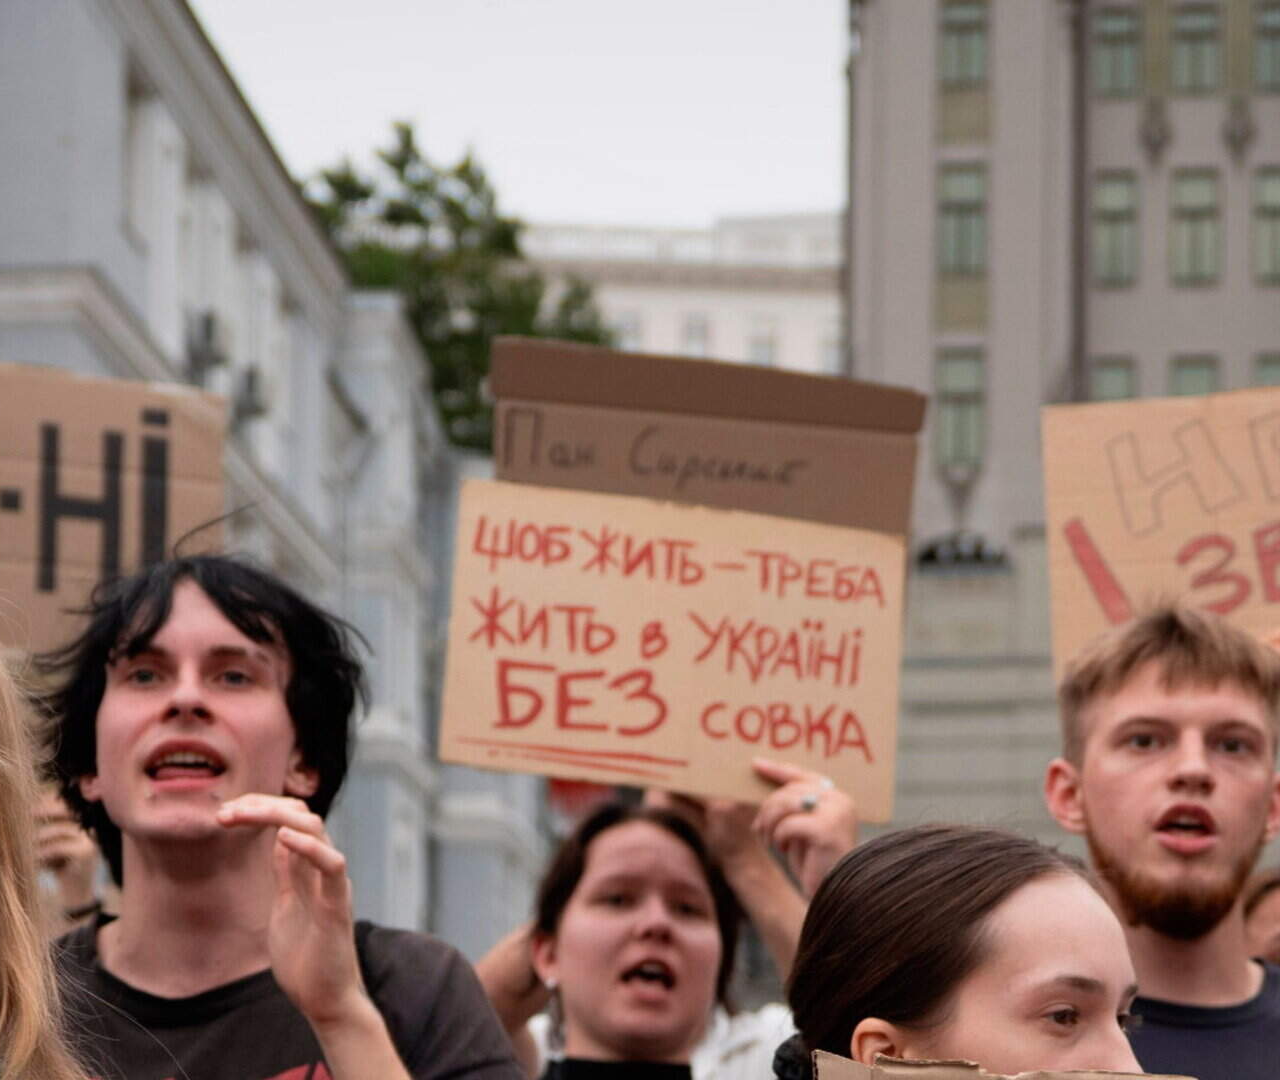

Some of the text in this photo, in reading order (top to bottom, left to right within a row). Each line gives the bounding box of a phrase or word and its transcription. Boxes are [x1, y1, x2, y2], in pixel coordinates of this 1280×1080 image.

[472, 515, 574, 573] ЩОБ
[469, 584, 617, 656] ЖИТЬ
[688, 609, 866, 687] УКРАЇНІ
[492, 658, 669, 738] БЕЗ
